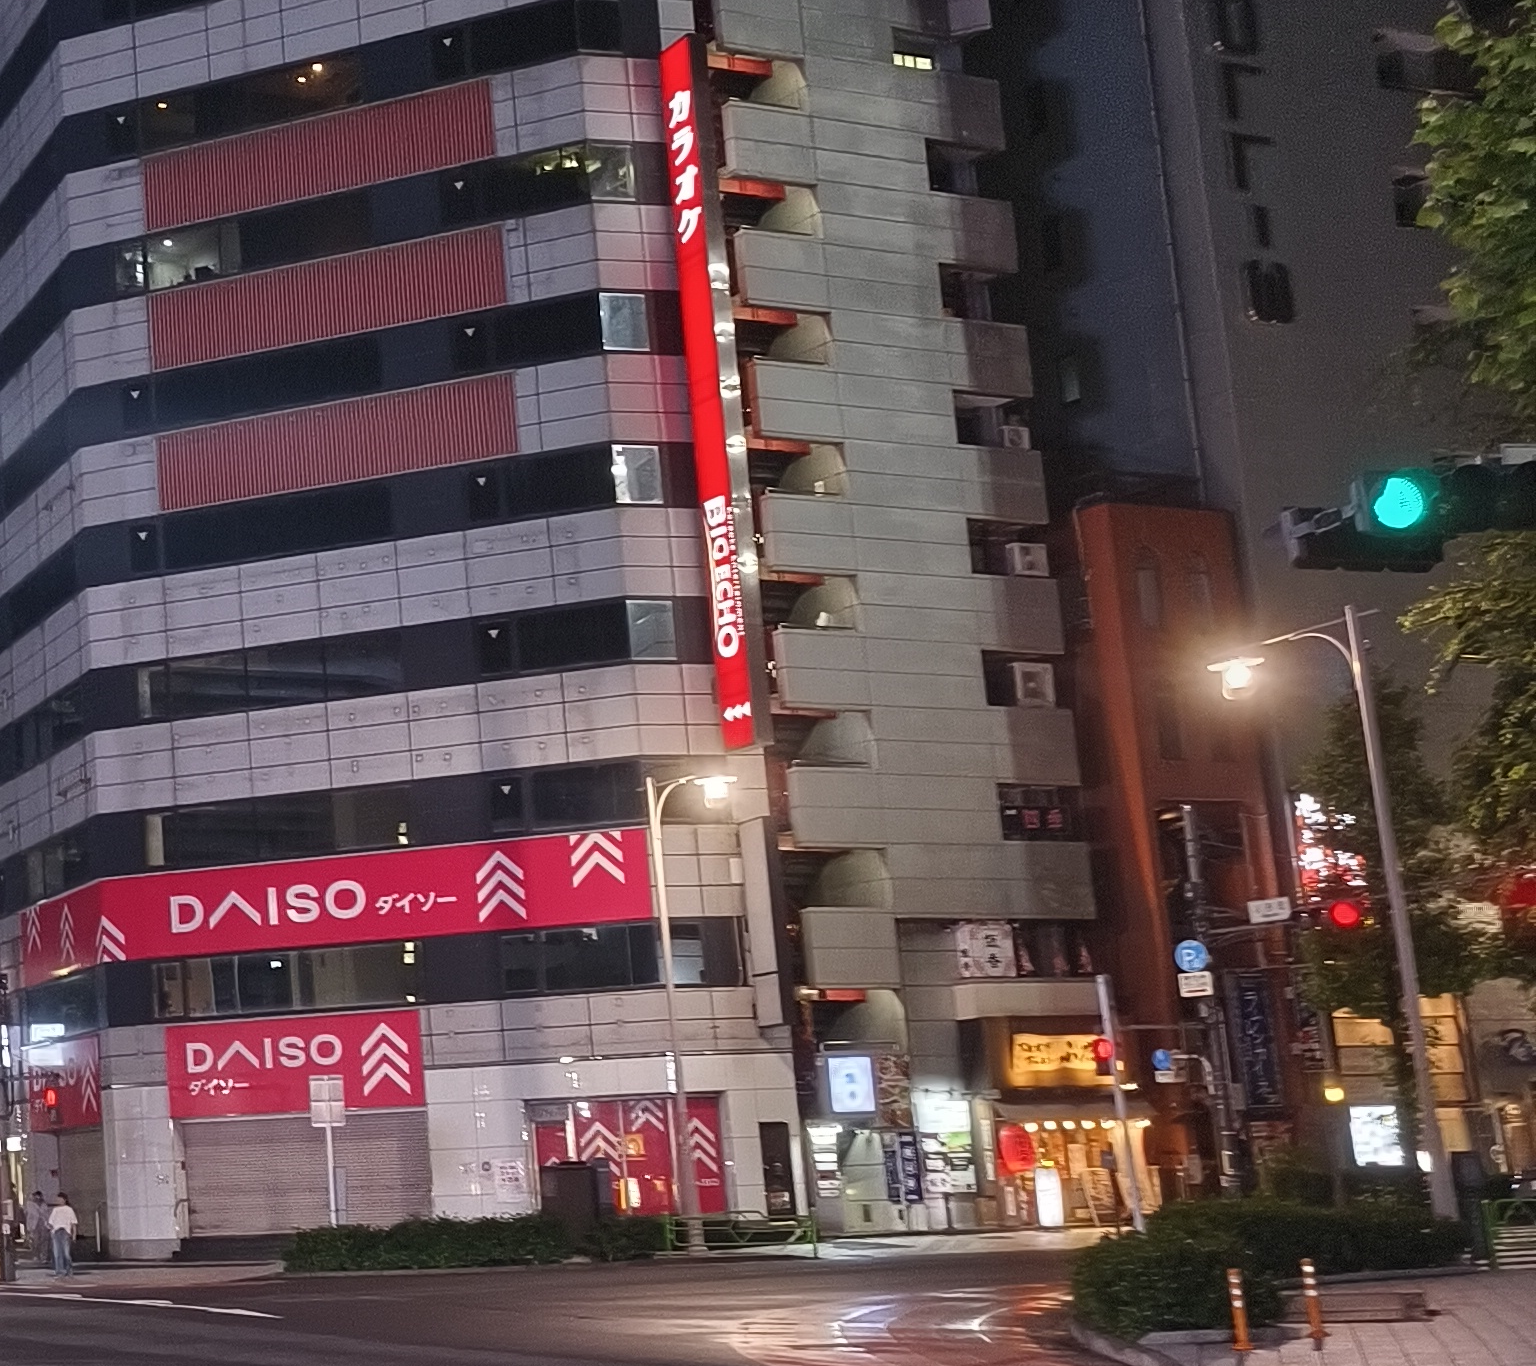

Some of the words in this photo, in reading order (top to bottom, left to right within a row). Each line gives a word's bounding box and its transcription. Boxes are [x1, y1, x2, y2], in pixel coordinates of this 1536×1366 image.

[669, 90, 702, 244] カラオケ
[703, 495, 729, 560] BIG
[714, 563, 740, 658] ECHO
[169, 880, 366, 934] DAISO
[375, 890, 458, 916] ダイソー
[186, 1034, 343, 1074] DAISO
[188, 1078, 250, 1097] ダイソー
